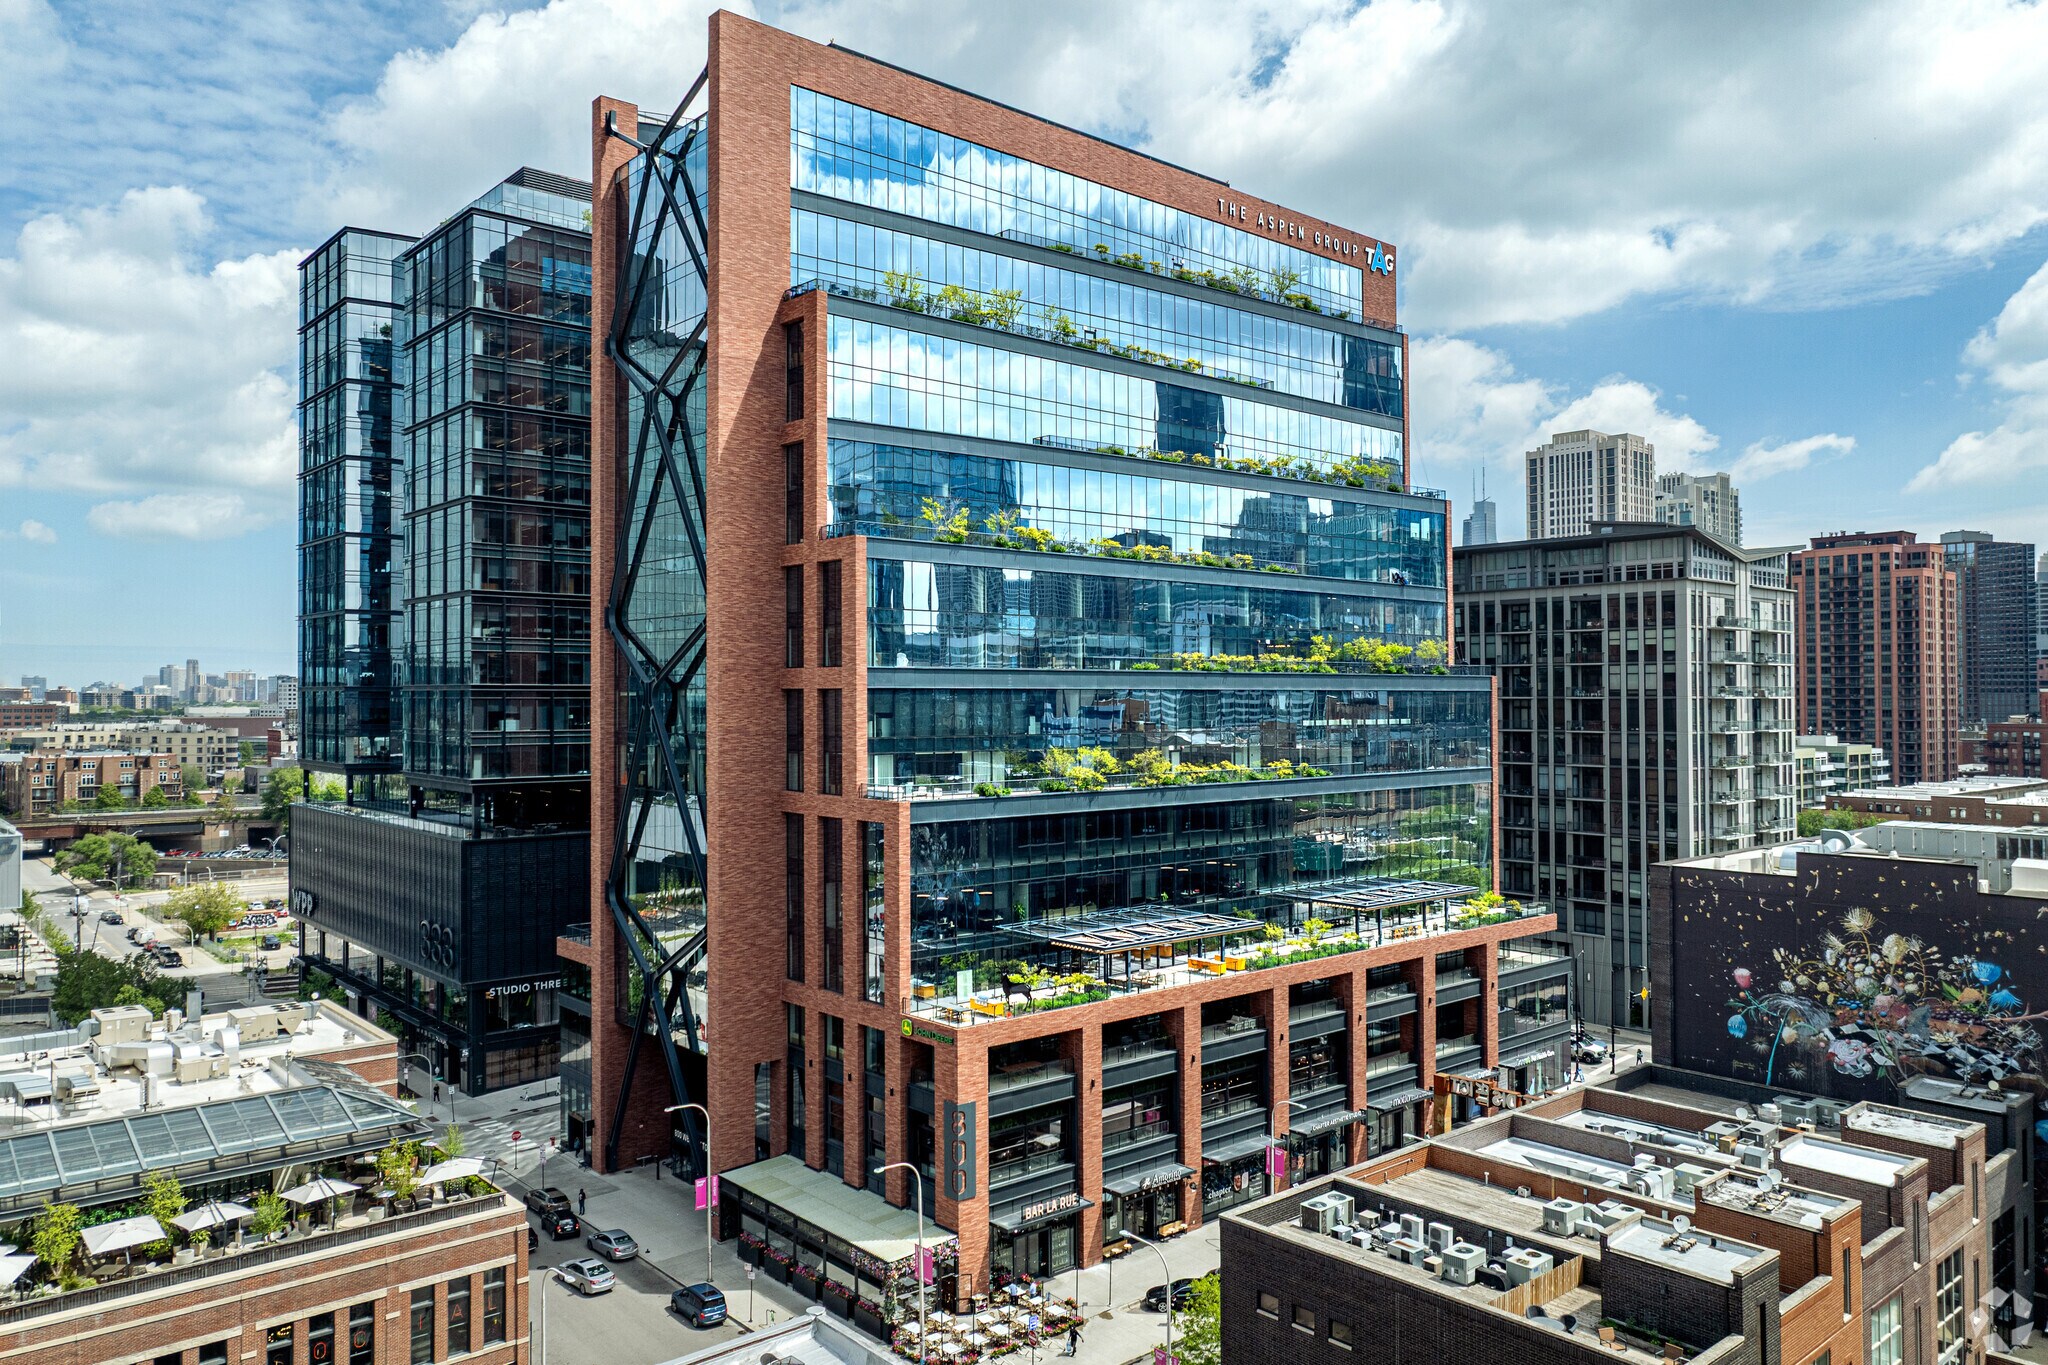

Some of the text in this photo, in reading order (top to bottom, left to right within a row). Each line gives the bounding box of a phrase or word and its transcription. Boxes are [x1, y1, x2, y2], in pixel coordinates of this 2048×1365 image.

[1218, 198, 1358, 257] THE ASPEN GROUP
[1365, 242, 1394, 276] TAG
[292, 888, 313, 917] WPP
[420, 920, 453, 968] 333
[489, 983, 531, 997] STUDIO
[914, 1026, 955, 1045] JOHN DEERE
[951, 1110, 967, 1196] 800
[1025, 1192, 1078, 1220] BAR LA RUE
